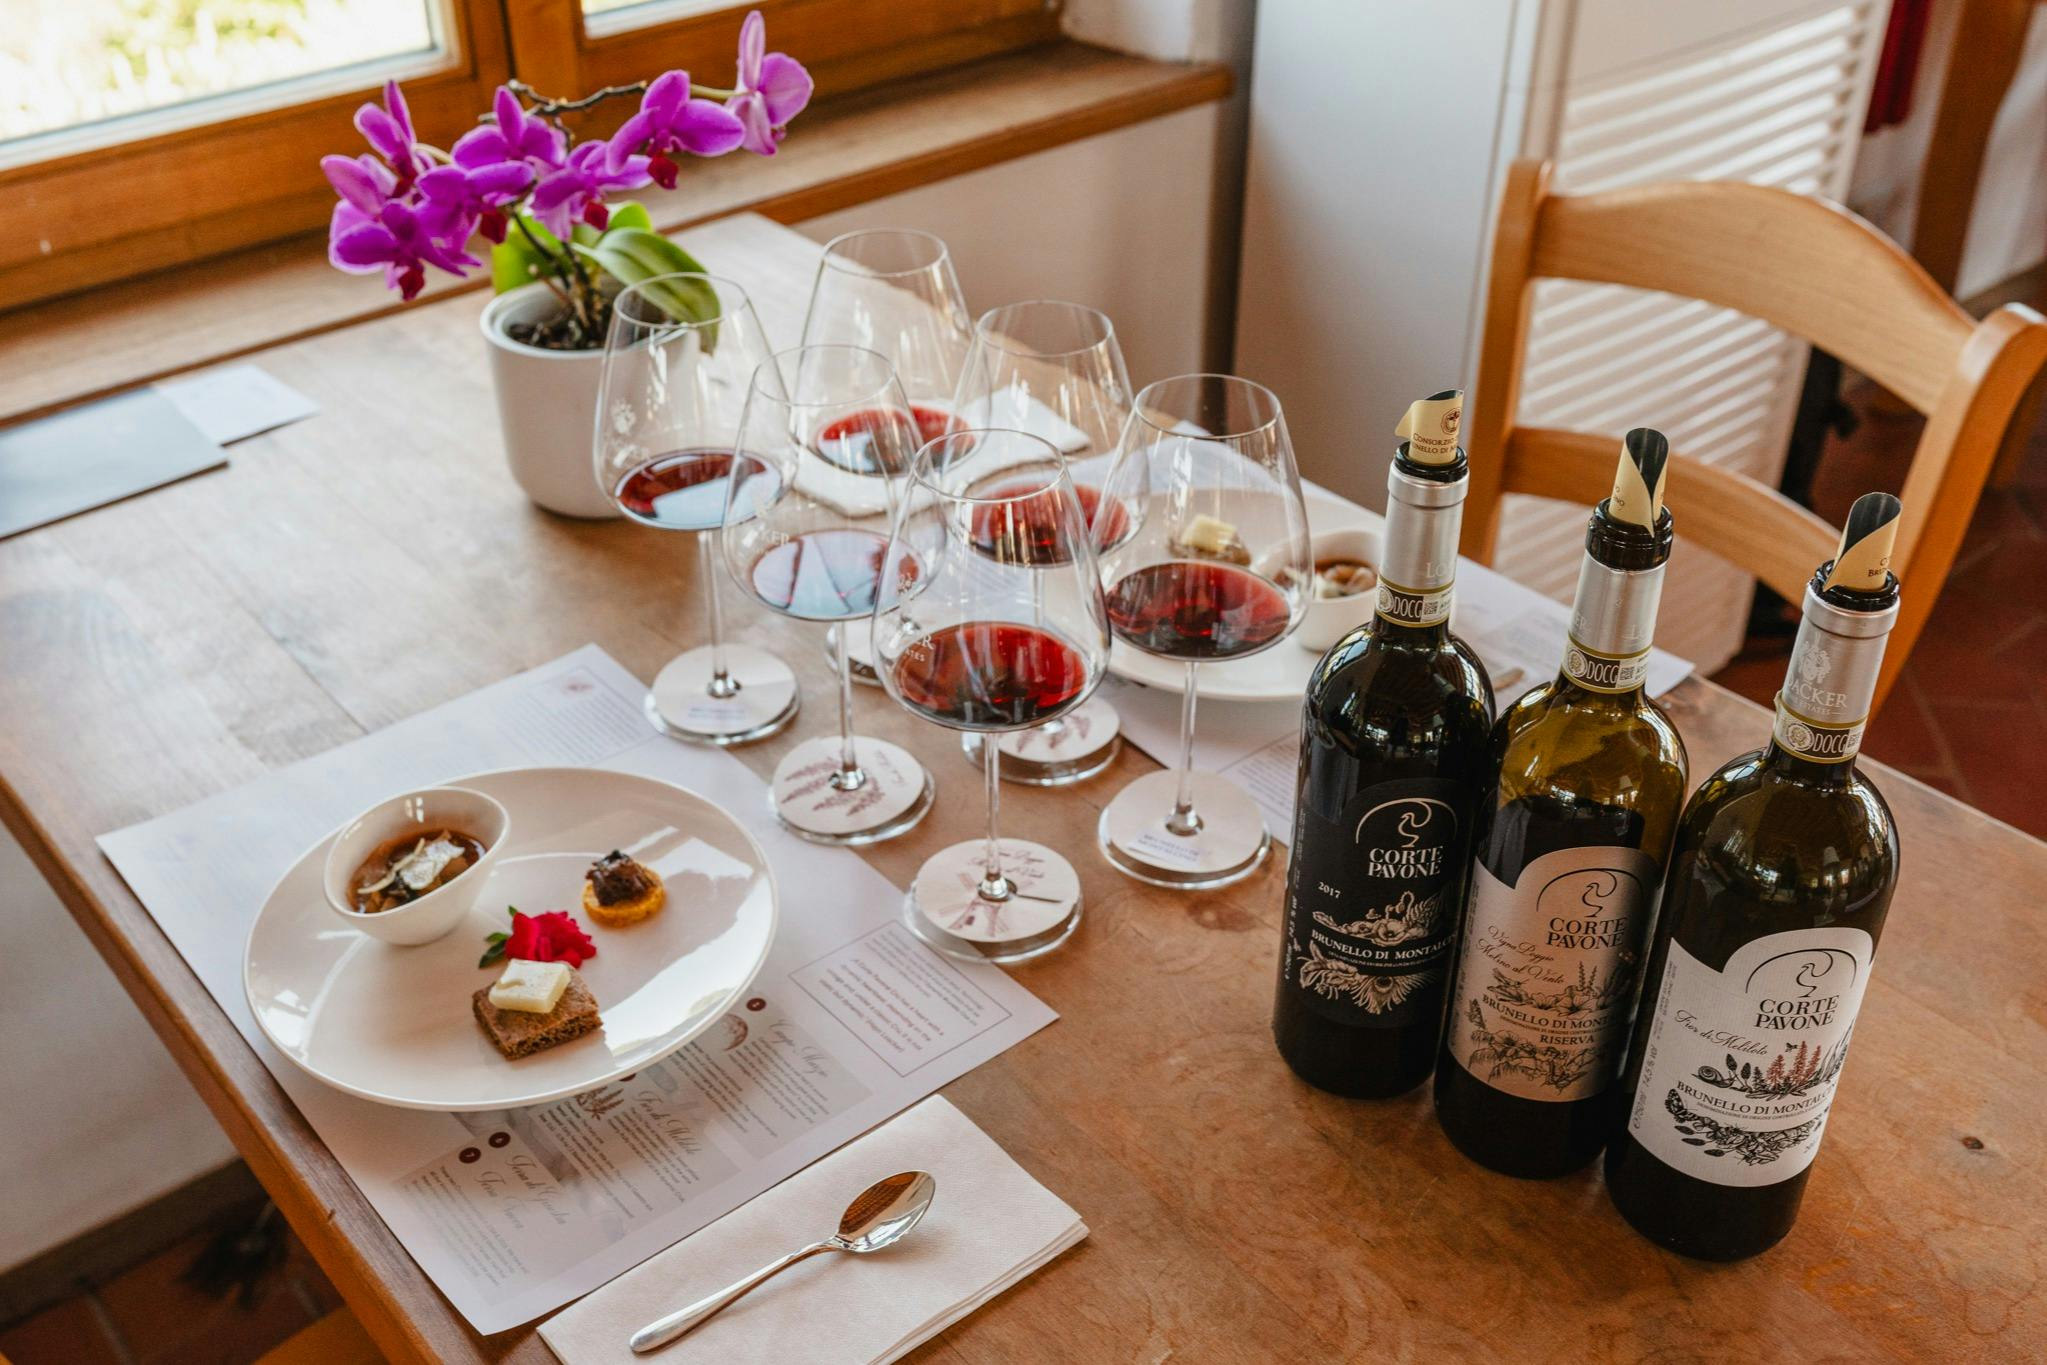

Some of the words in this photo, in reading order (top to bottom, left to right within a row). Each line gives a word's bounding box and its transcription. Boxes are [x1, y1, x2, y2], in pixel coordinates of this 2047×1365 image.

[1393, 597, 1423, 618] DOCG
[1586, 661, 1620, 684] DOCG
[1813, 733, 1849, 753] DOCG
[1369, 846, 1443, 864] CORTE
[1368, 862, 1441, 878] PAVONE
[1318, 882, 1341, 899] 2017
[1550, 917, 1627, 935] CORTE
[1312, 929, 1372, 958] BRUNELLO
[1375, 950, 1389, 959] DI
[1547, 932, 1625, 949] PAVONE
[1483, 995, 1549, 1027] BRUNELLO
[1552, 1020, 1567, 1028] DI
[1759, 995, 1839, 1015] CORTE
[1675, 1010, 1698, 1032] Fior
[1700, 1030, 1714, 1039] di
[1754, 1011, 1836, 1030] PAVONE
[1540, 1034, 1594, 1045] RISERVA
[1677, 1081, 1750, 1113] BRUNELLO
[1754, 1106, 1769, 1114] DI
